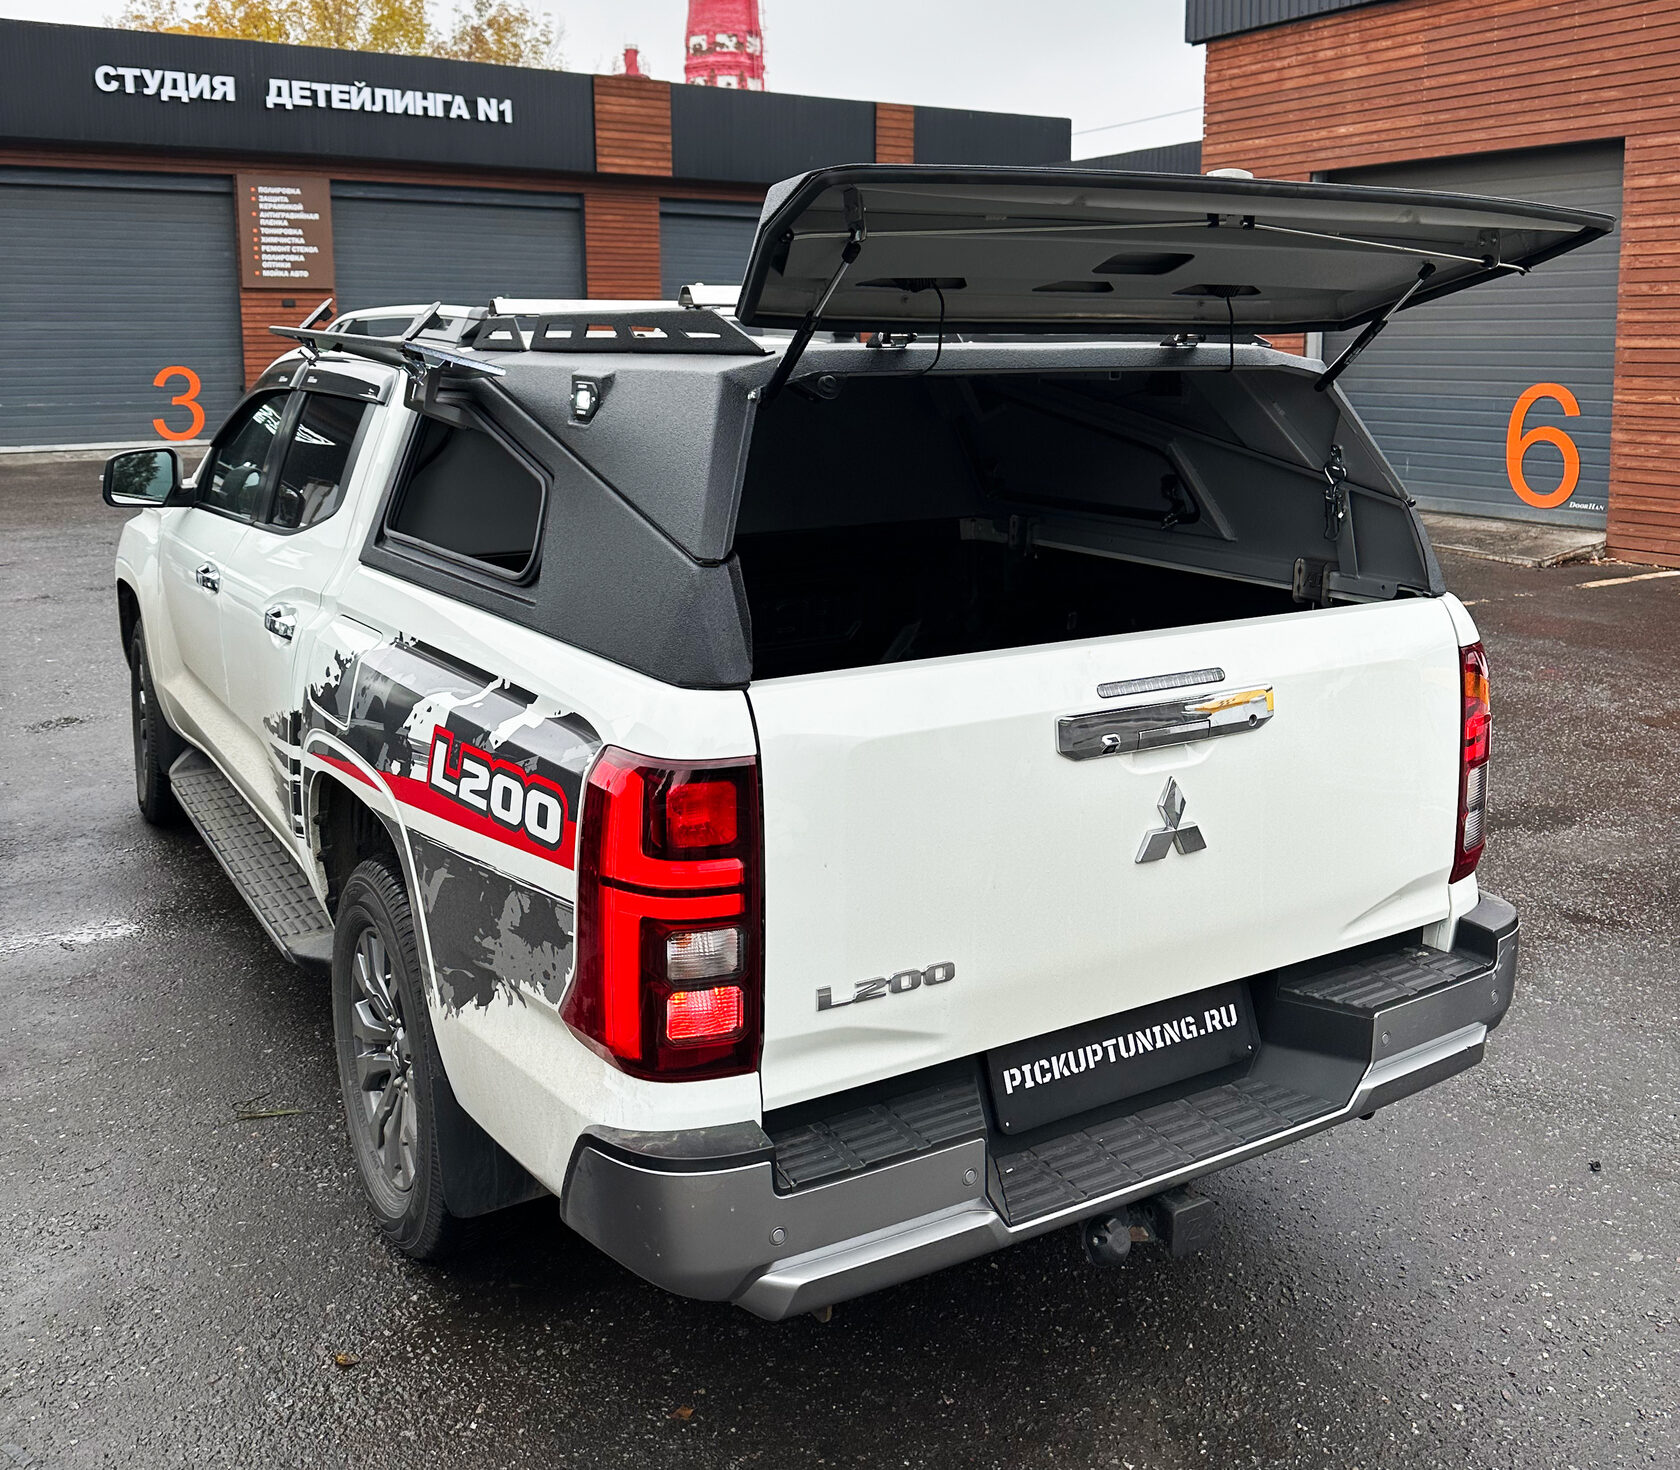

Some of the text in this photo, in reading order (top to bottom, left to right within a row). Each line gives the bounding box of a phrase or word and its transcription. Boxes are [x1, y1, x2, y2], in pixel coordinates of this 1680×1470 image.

[94, 65, 515, 124] СТУДИЯ ДЕТЕЙЛИНГА N1
[152, 365, 206, 441] 3
[1506, 382, 1581, 509] 6
[430, 738, 562, 845] L200
[815, 961, 956, 1012] L200
[1002, 1003, 1239, 1095] PICKUPTUNING.RU
